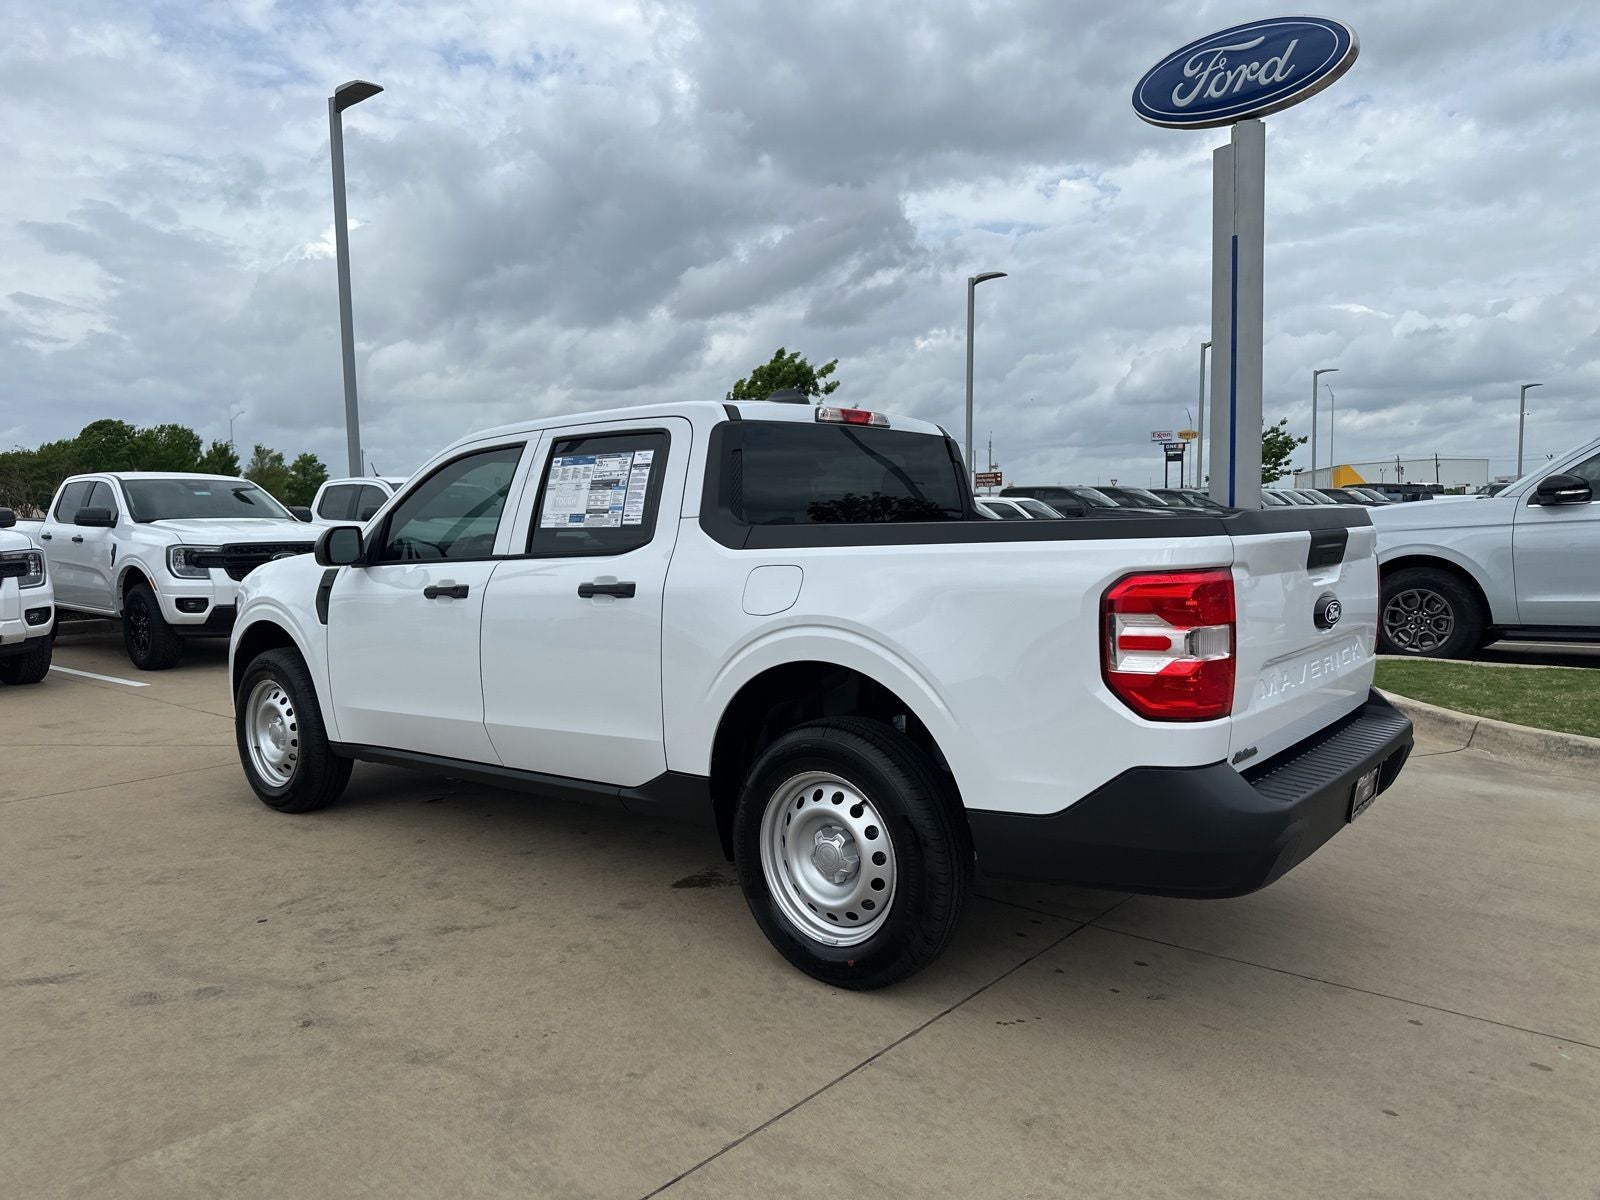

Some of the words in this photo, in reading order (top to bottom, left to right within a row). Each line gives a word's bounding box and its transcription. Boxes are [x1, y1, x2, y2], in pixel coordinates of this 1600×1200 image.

[1171, 36, 1299, 107] Ford
[1152, 431, 1171, 439] Exxon
[1259, 642, 1361, 699] MAVERICK
